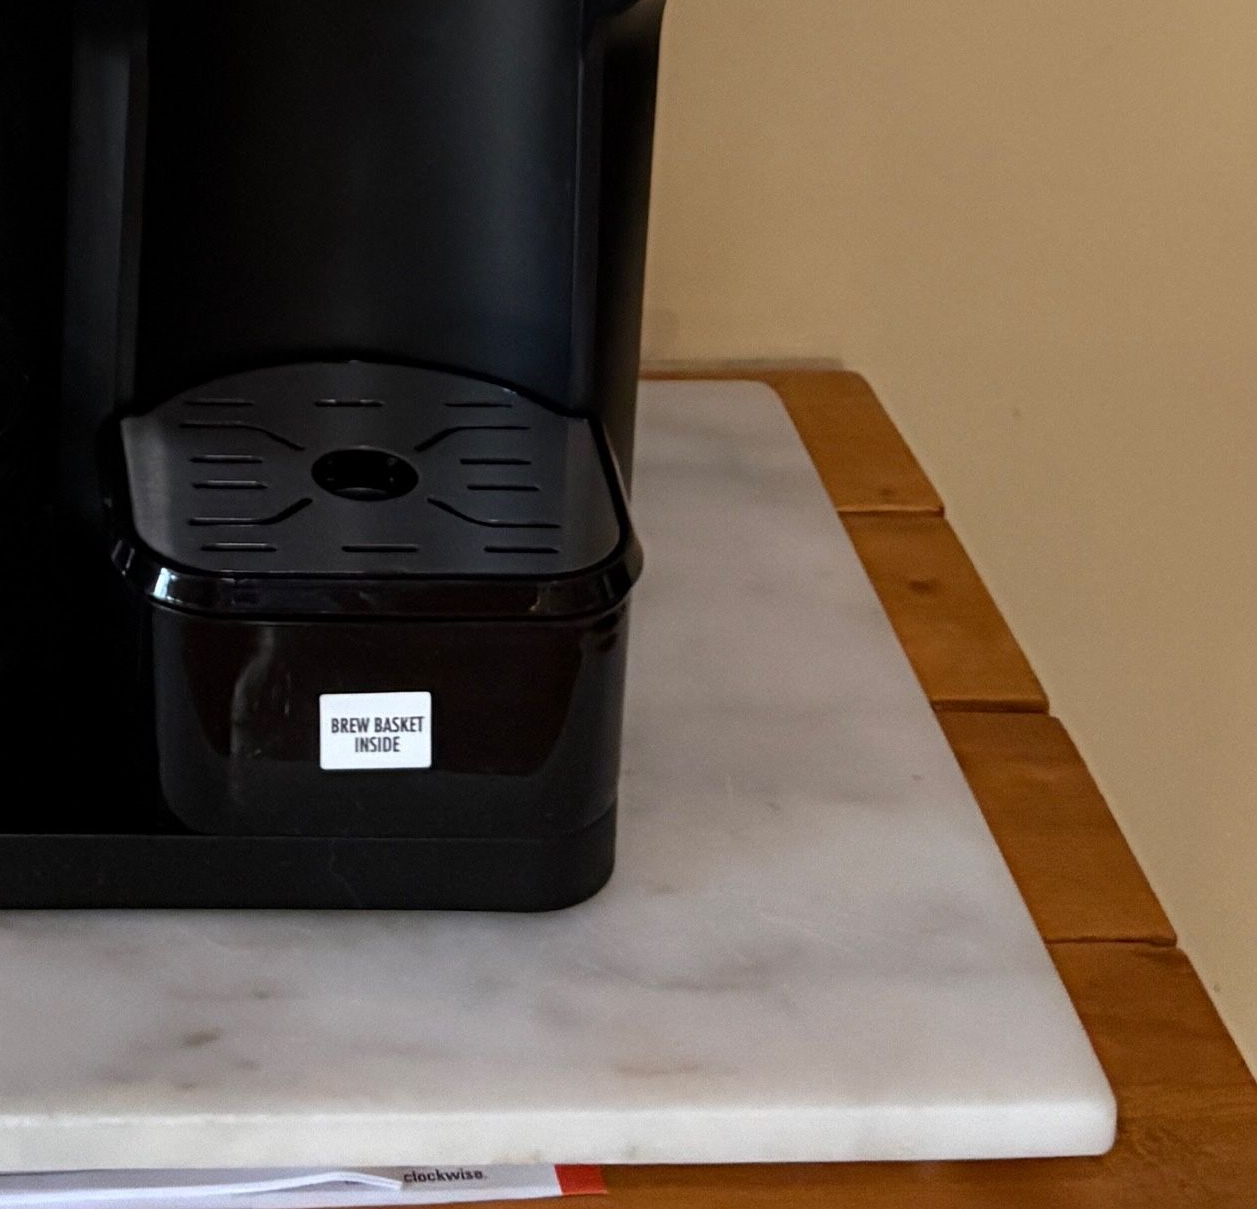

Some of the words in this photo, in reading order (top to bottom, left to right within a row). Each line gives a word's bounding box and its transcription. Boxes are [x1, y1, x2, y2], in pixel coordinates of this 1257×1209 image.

[331, 717, 370, 733] BREW
[374, 716, 424, 733] BASKET
[355, 736, 400, 752] INSIDE
